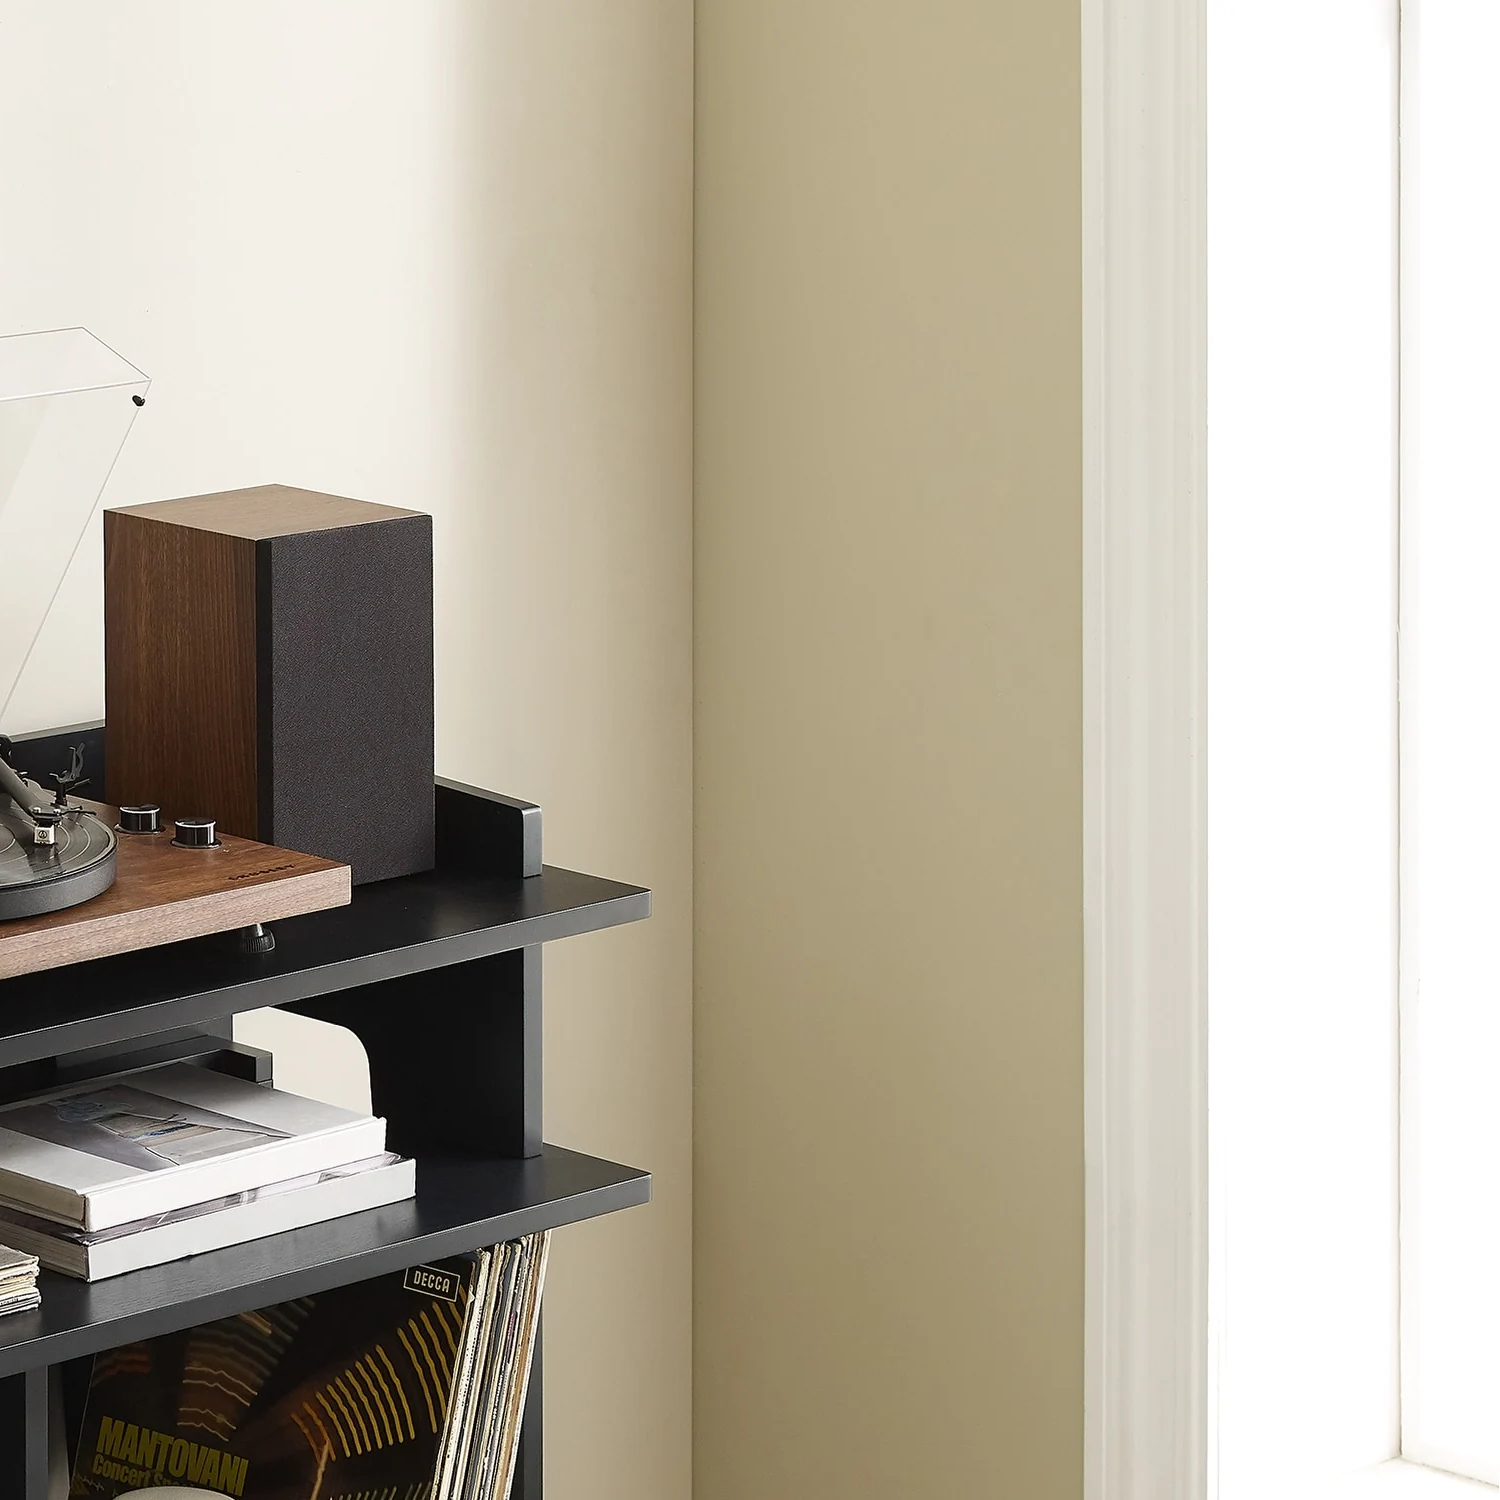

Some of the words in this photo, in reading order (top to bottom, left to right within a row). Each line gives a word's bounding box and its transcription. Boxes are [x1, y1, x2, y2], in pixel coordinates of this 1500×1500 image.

[414, 1270, 450, 1293] DECCA
[92, 1454, 150, 1487] Concert
[96, 1416, 249, 1497] MANTOVANI
